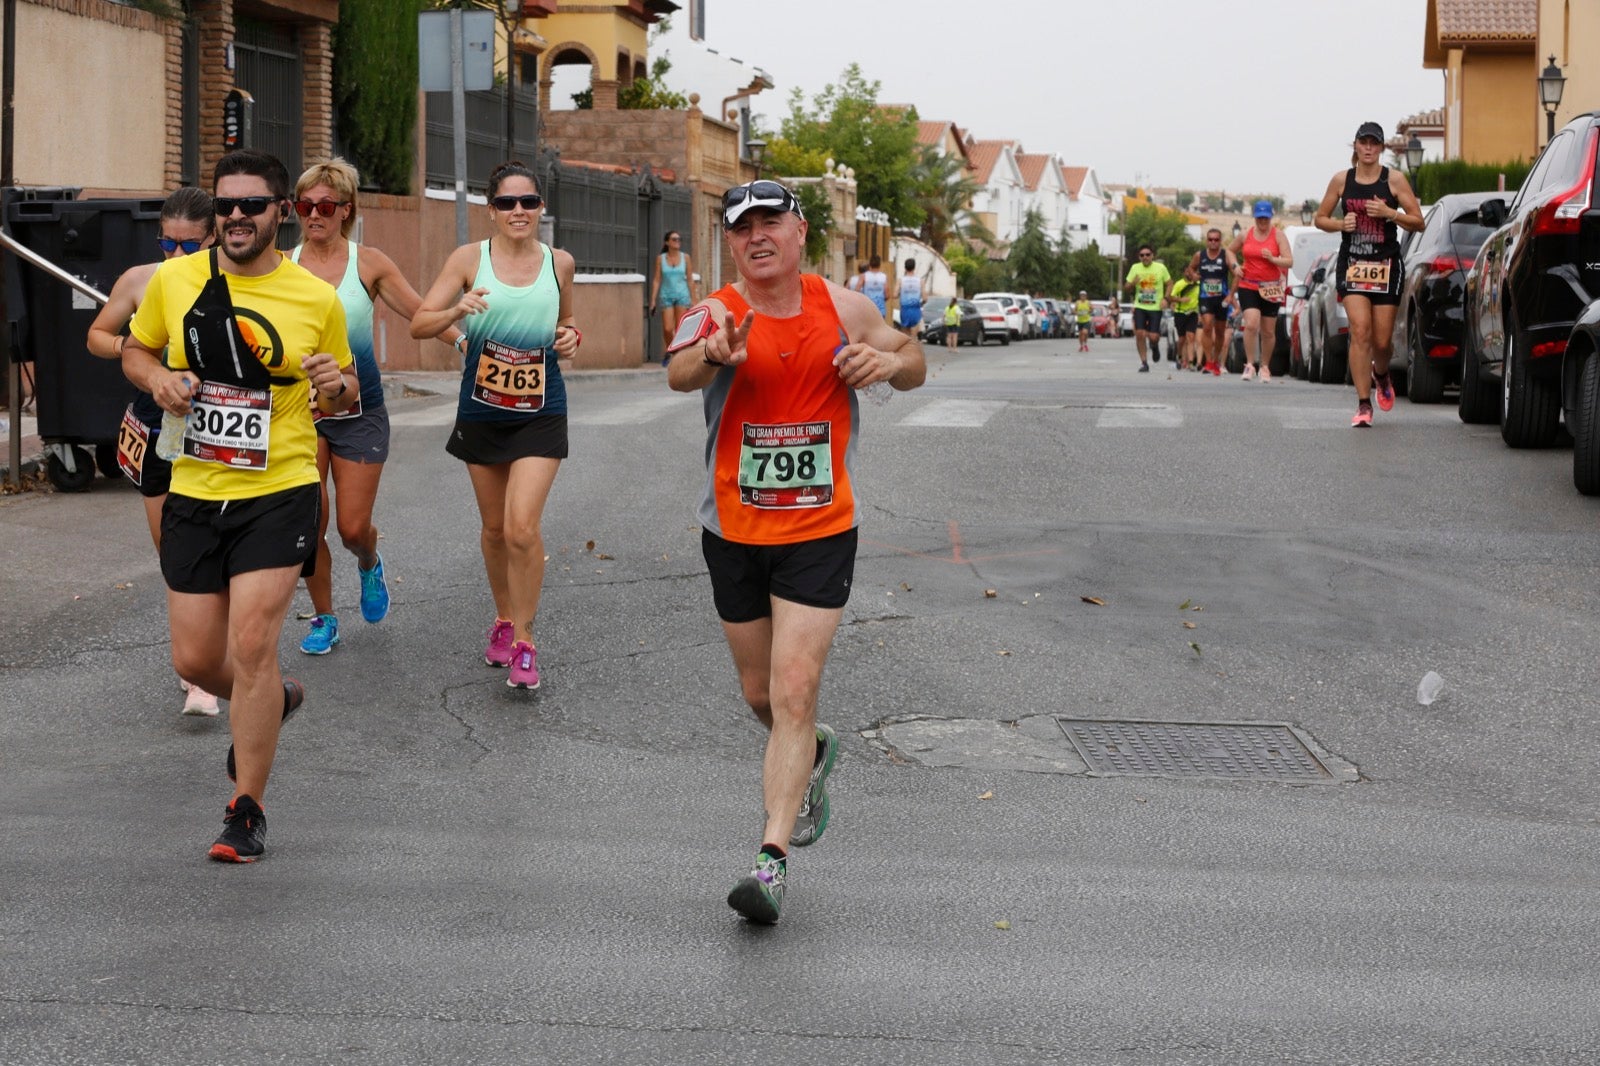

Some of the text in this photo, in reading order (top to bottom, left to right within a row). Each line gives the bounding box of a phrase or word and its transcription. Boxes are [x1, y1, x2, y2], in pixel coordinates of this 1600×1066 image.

[1352, 266, 1386, 280] 2161
[497, 345, 509, 355] GRAN
[485, 363, 540, 390] 2163
[203, 384, 218, 397] GRAN
[218, 386, 239, 398] PREMIO
[247, 390, 266, 401] FONDO
[192, 406, 262, 440] 3026
[757, 427, 773, 438] GRAN
[774, 426, 796, 438] PREMIO
[796, 426, 804, 437] DE
[805, 425, 825, 436] FONDO
[752, 450, 817, 482] 798
